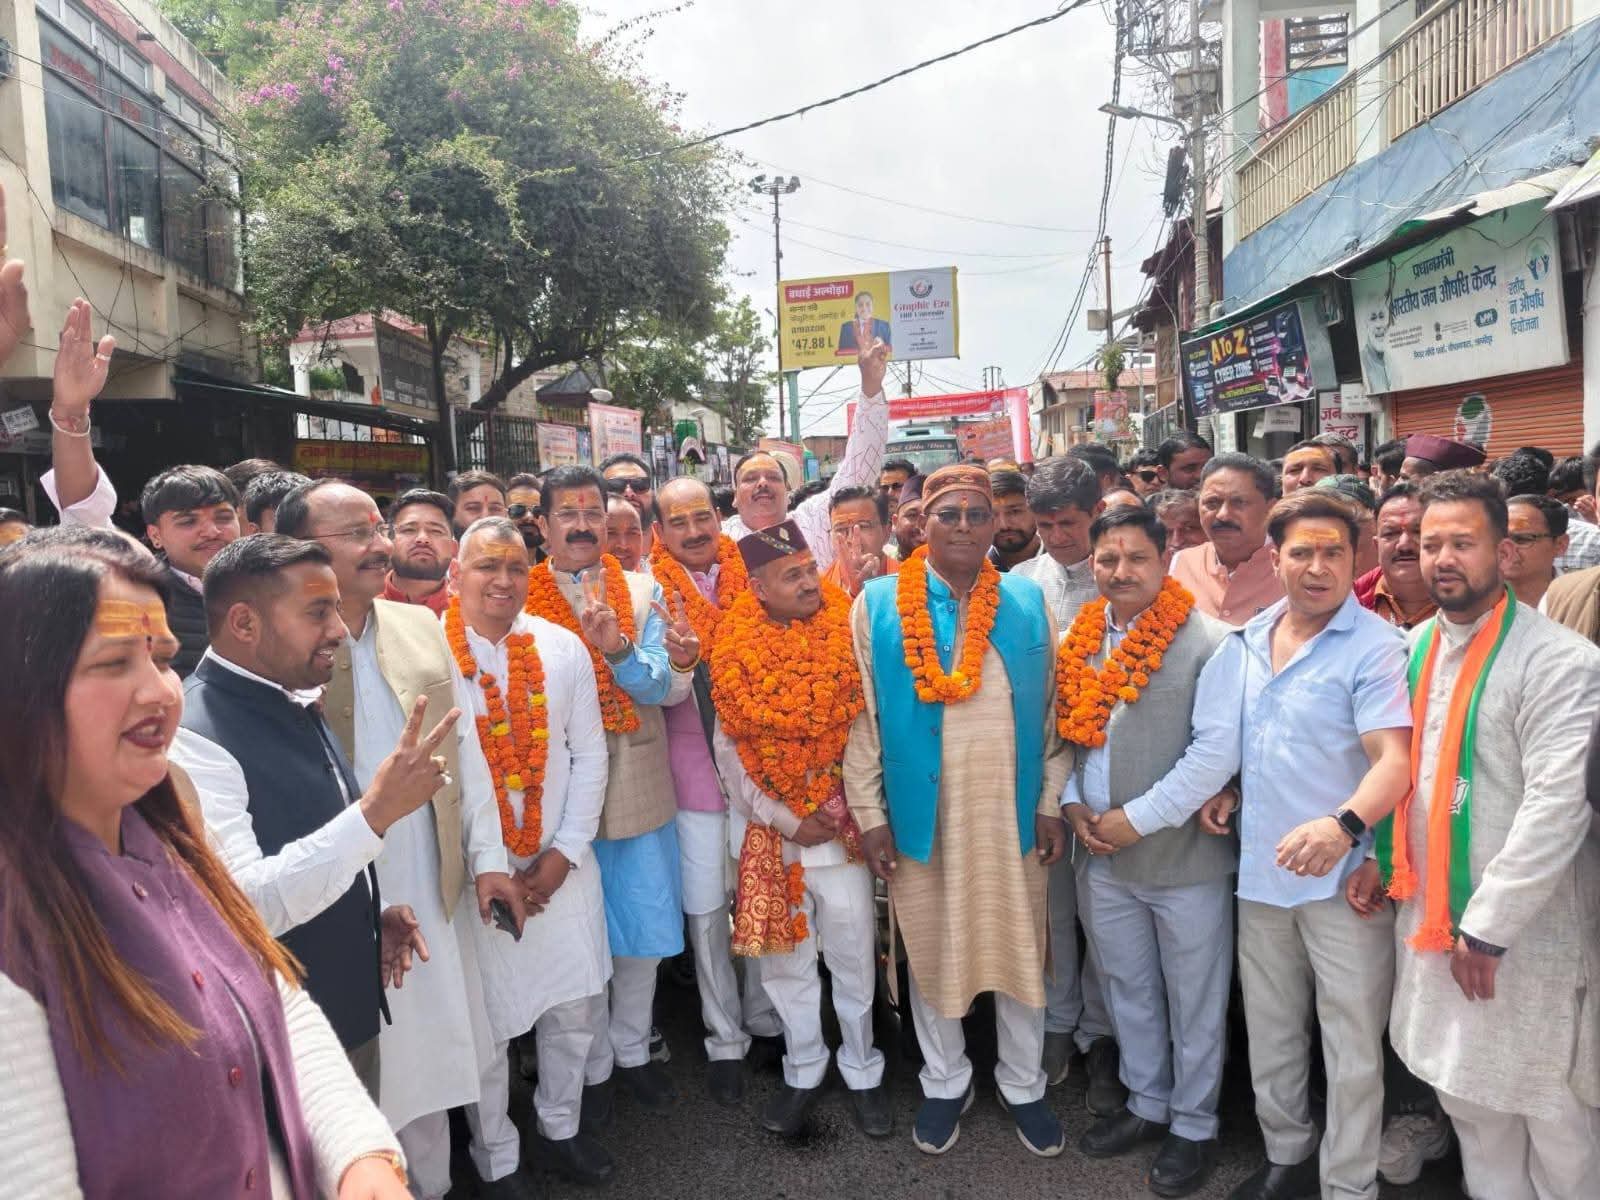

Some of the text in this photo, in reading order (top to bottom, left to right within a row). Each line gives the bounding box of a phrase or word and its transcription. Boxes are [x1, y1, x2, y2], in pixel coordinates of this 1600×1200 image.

[1412, 246, 1455, 280] प्रधानमंत्री
[1421, 286, 1437, 307] जन
[1439, 270, 1469, 303] औषधि
[1470, 264, 1497, 291] केन्द्र
[1233, 327, 1249, 356] Z
[1214, 365, 1235, 385] CYBER
[1234, 360, 1254, 378] ZONE
[1320, 407, 1342, 421] जन
